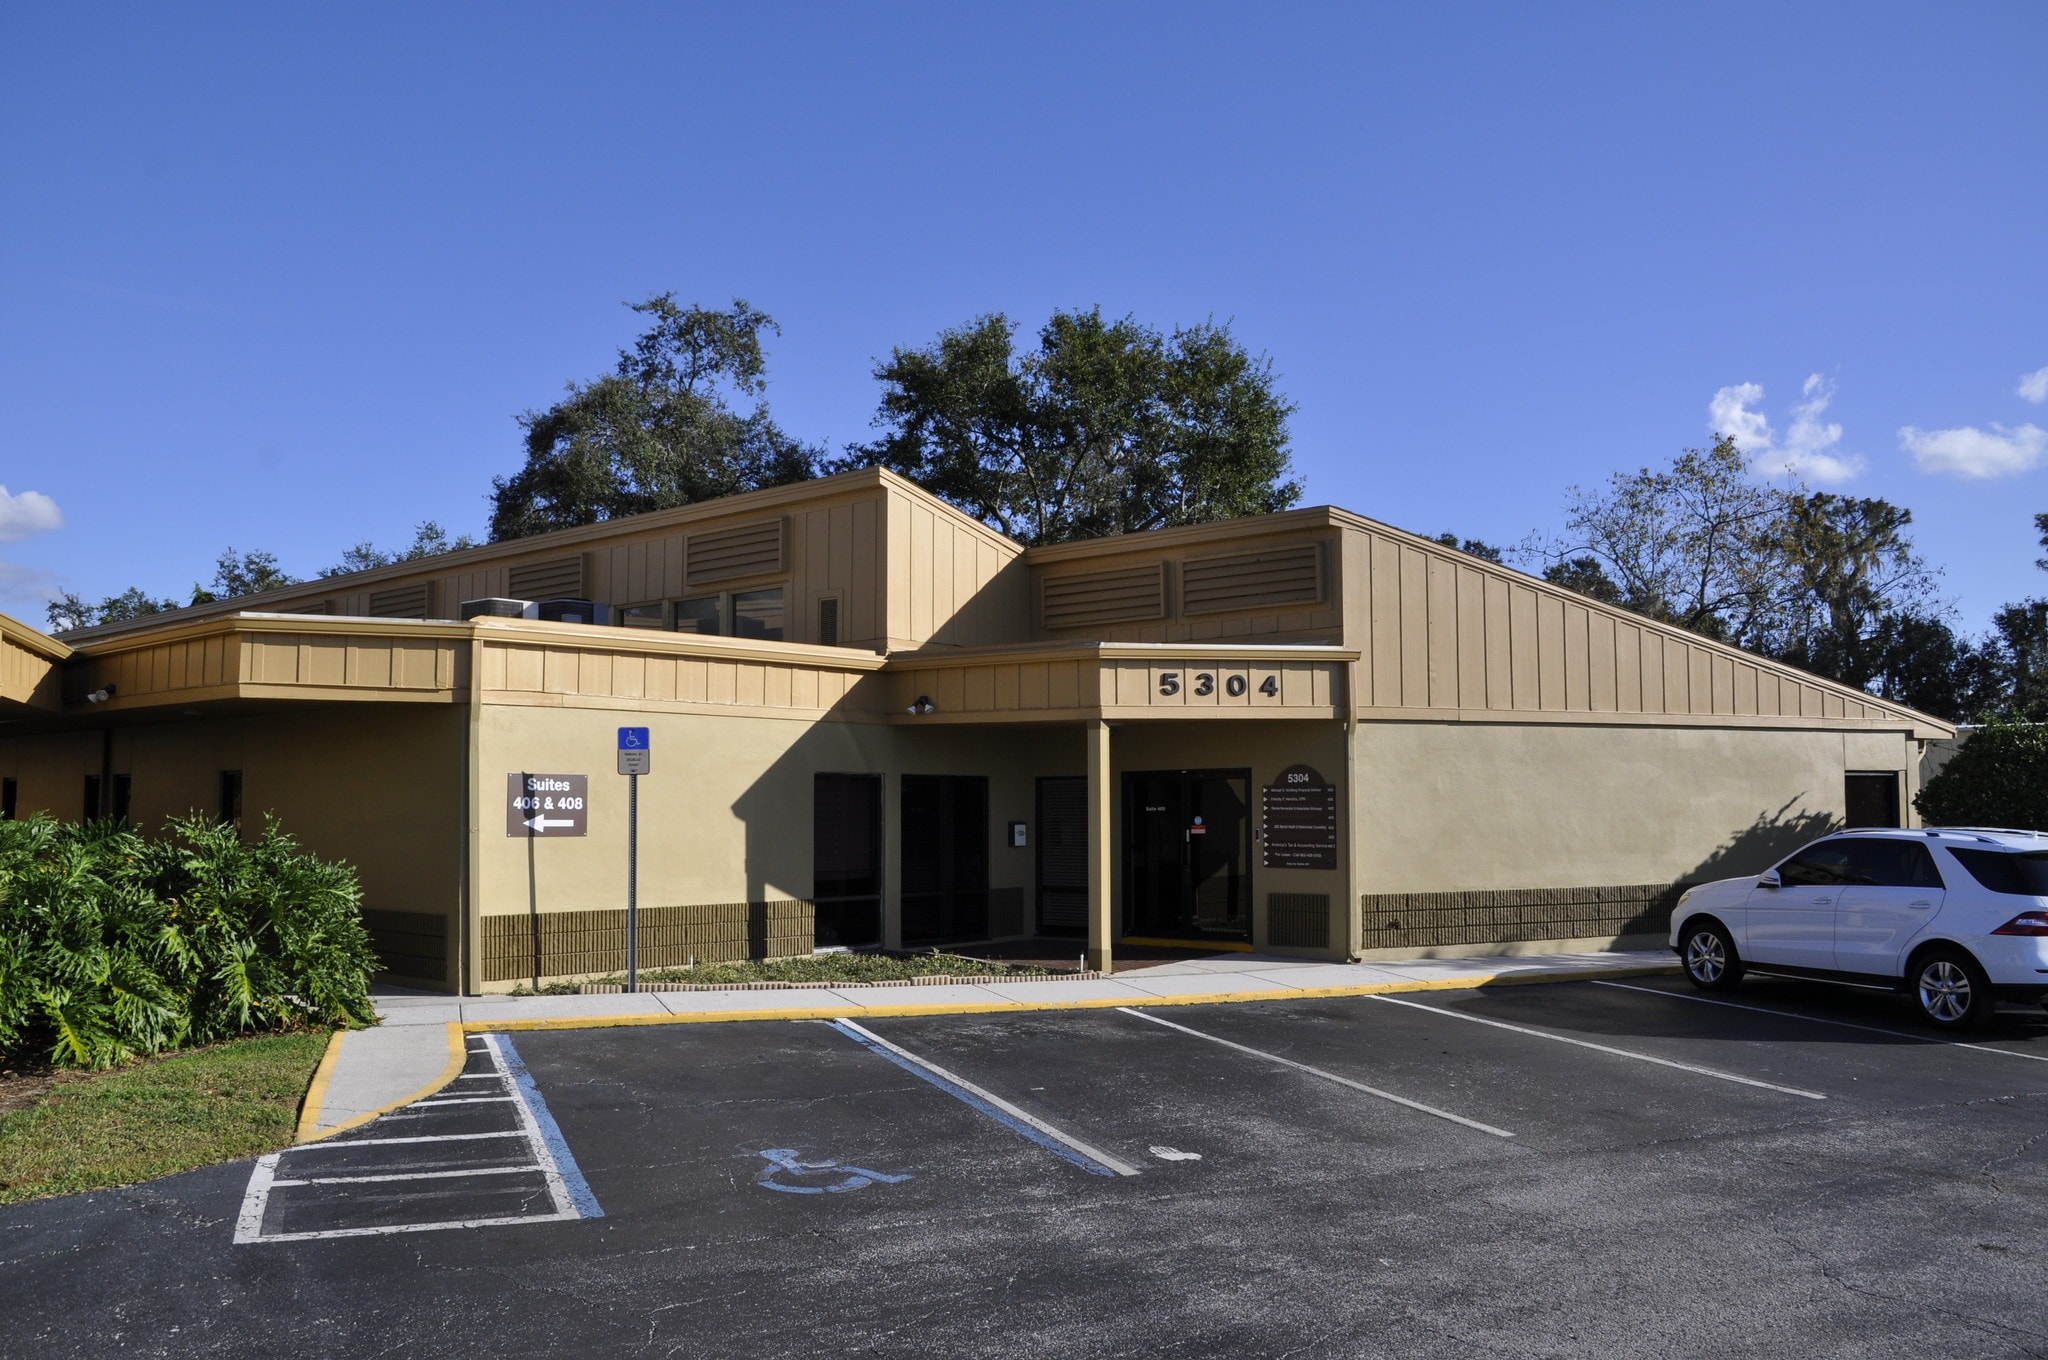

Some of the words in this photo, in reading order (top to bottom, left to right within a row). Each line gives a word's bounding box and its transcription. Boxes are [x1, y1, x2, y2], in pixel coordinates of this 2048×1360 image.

[1159, 673, 1279, 697] 5304
[527, 777, 571, 791] Suites
[1287, 773, 1309, 783] 5304
[513, 796, 540, 810] 406
[543, 796, 555, 810] &
[557, 797, 583, 810] 408
